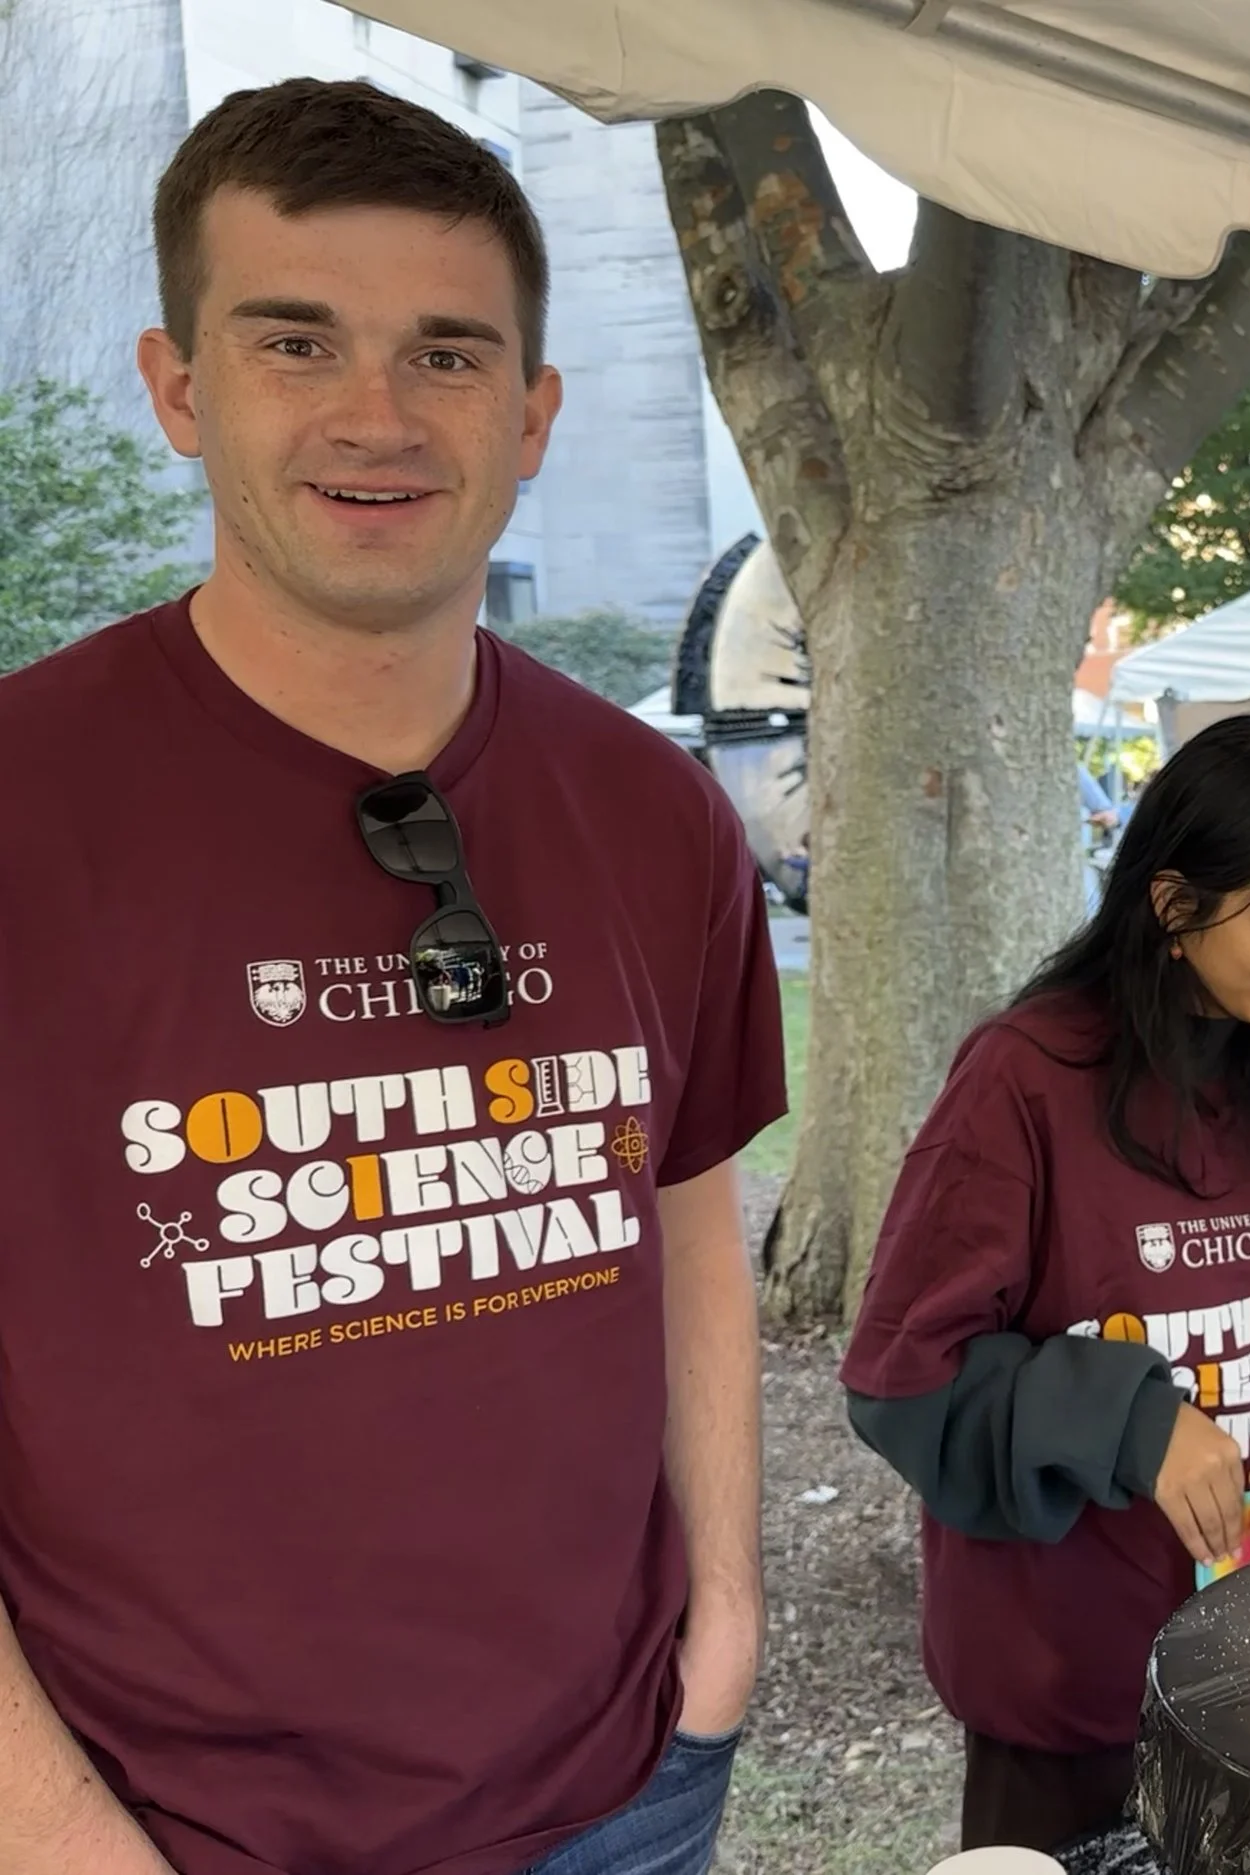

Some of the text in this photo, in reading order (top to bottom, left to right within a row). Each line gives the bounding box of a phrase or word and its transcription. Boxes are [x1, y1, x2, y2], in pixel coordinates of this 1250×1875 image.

[314, 956, 368, 977] THE
[518, 942, 548, 961] OF
[318, 967, 553, 1022] CHIO
[121, 1045, 652, 1174] SOUTH SIDE
[216, 1121, 608, 1244] SCIENCE
[1176, 1218, 1208, 1235] THE
[182, 1189, 641, 1328] FESTIVAL
[228, 1266, 620, 1362] WHERE SCIENCE IS FOR EVERYONE
